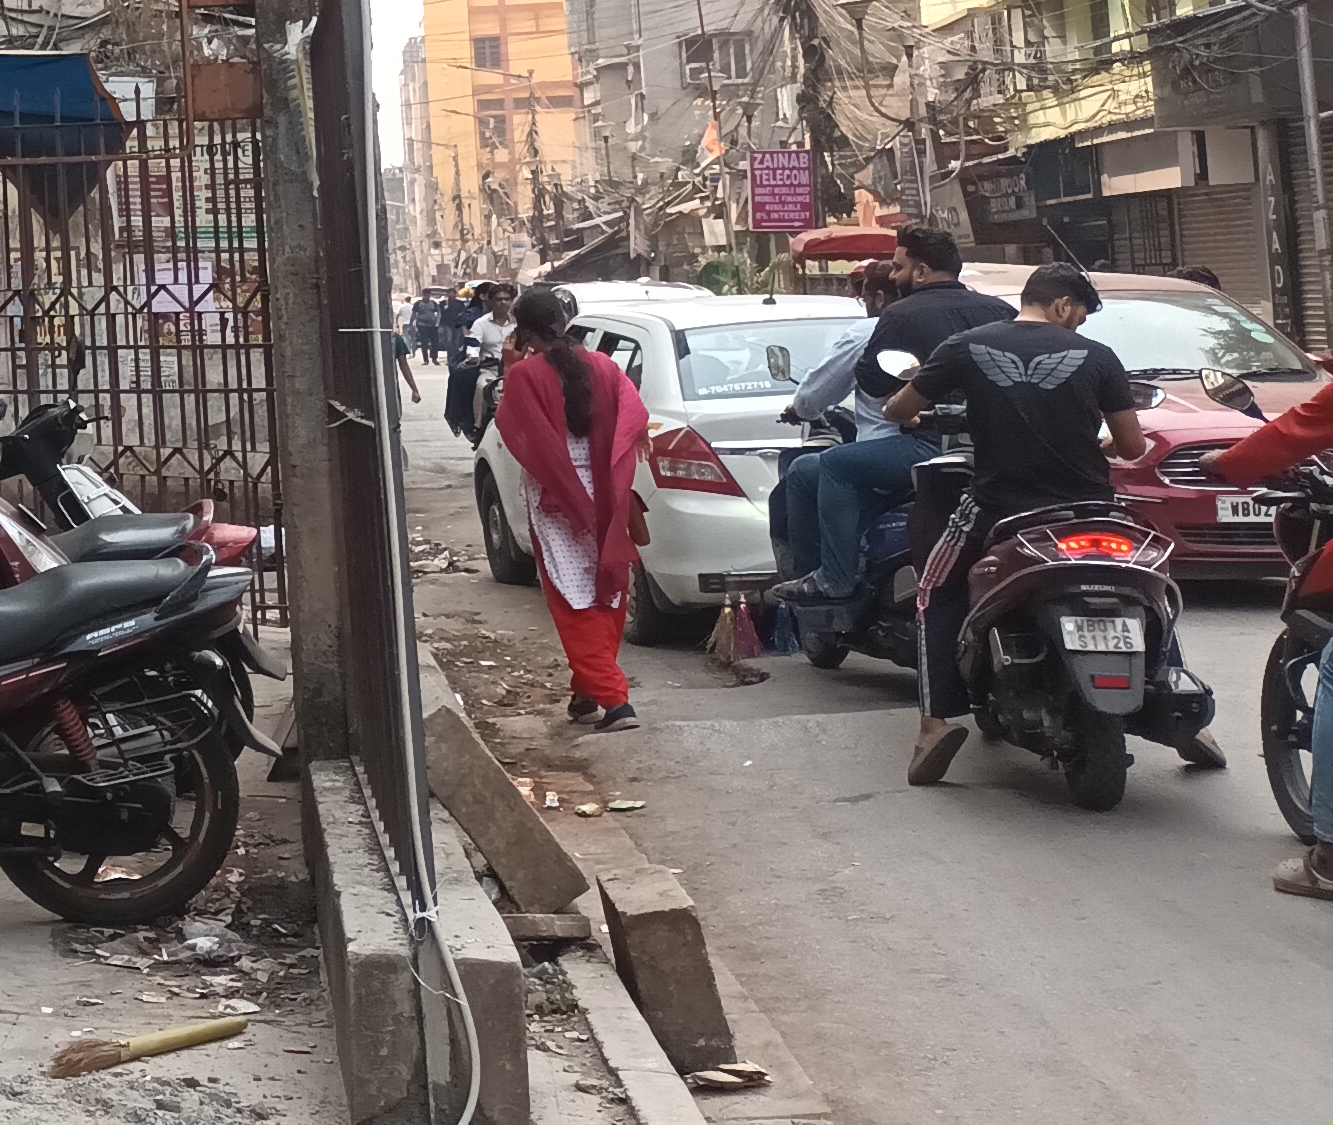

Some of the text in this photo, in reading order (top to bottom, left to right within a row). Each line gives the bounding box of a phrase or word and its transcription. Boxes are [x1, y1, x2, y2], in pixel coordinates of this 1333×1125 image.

[753, 152, 809, 169] ZAINAB
[753, 169, 810, 185] TELECOM
[1074, 618, 1131, 634] WB01A
